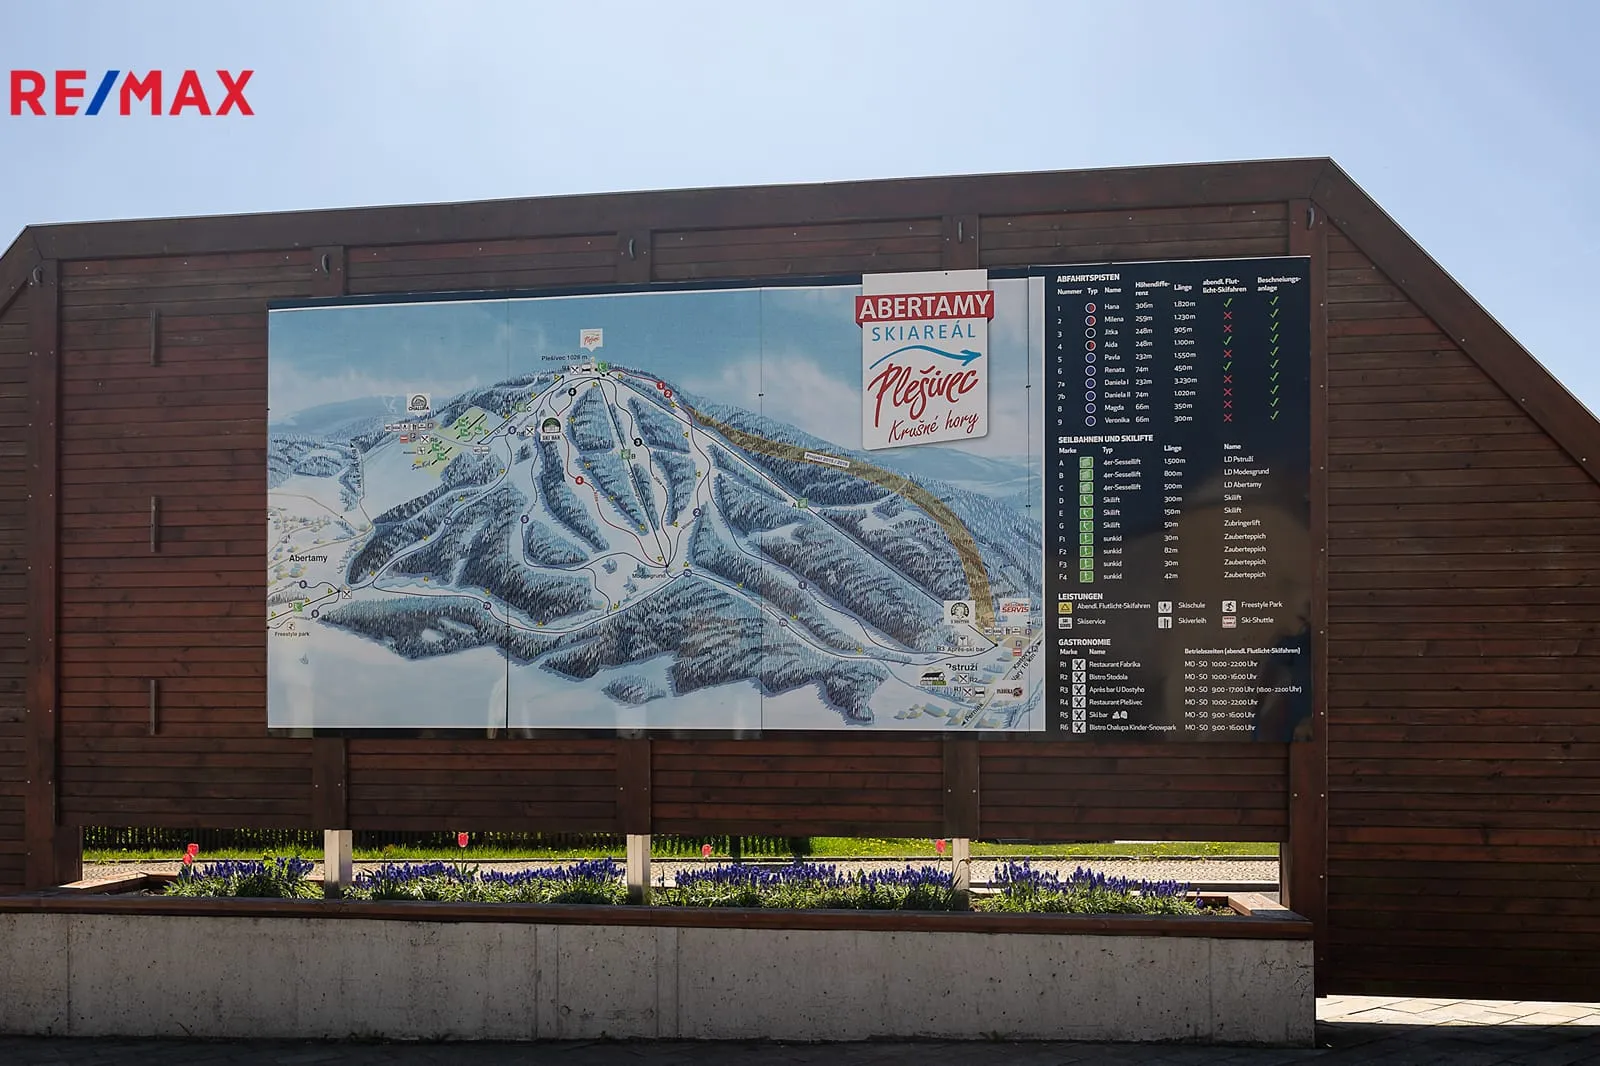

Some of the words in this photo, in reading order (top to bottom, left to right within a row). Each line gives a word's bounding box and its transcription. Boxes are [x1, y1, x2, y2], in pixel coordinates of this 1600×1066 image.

[1057, 273, 1120, 283] ABFAHRTSPISTEN
[859, 294, 991, 320] ABERTAMY
[872, 320, 976, 341] SKIAREÁL
[867, 363, 978, 428] Plešivec
[888, 416, 939, 443] Krušné
[945, 410, 979, 434] hory
[1058, 436, 1104, 444] SEILBAHNEN
[1224, 520, 1260, 528] Zubringerlift
[1224, 533, 1266, 541] Zauberteppich
[289, 554, 328, 563] Abertamy
